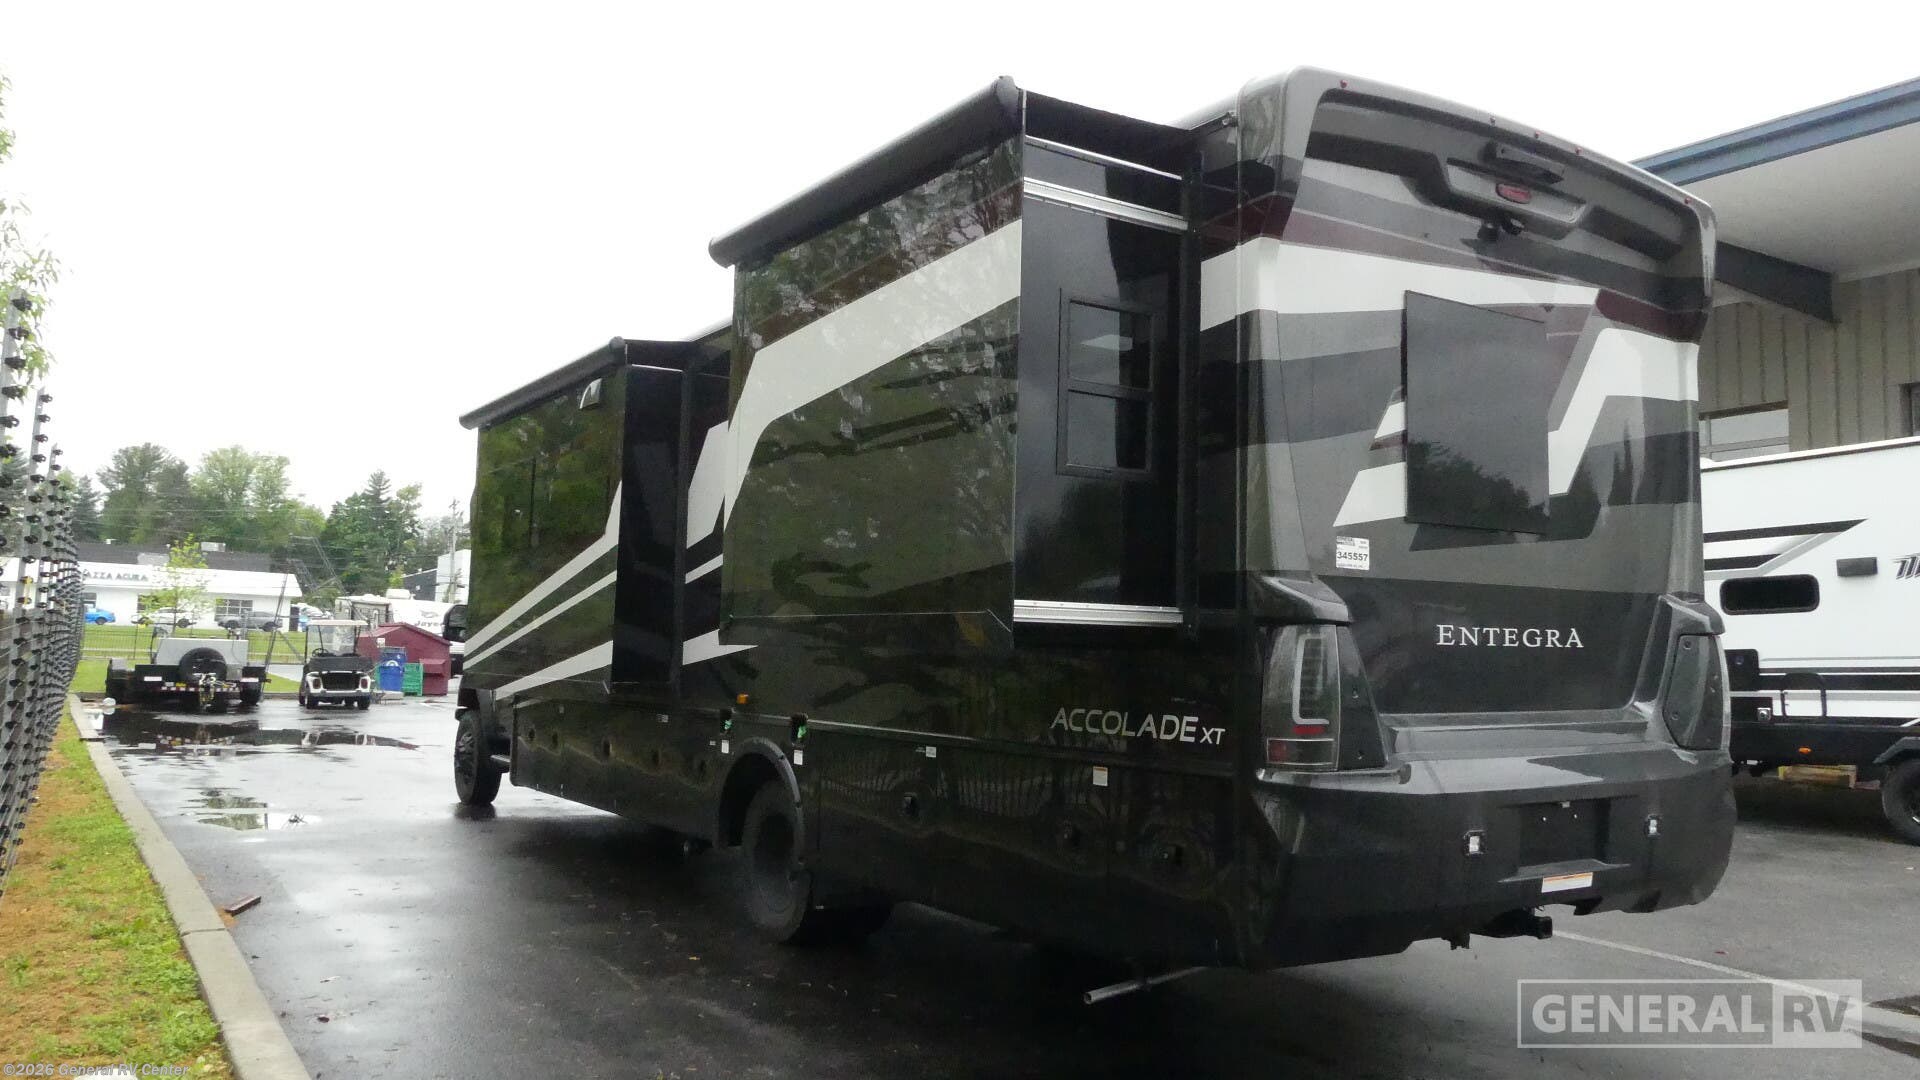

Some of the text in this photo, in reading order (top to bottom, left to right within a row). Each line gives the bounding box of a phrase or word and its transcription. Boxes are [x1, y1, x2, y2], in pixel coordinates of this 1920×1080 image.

[1336, 551, 1368, 561] 345557
[115, 572, 148, 581] ACURA
[1436, 624, 1584, 648] ENTEGRA
[1050, 707, 1226, 745] ACCOLADE XT
